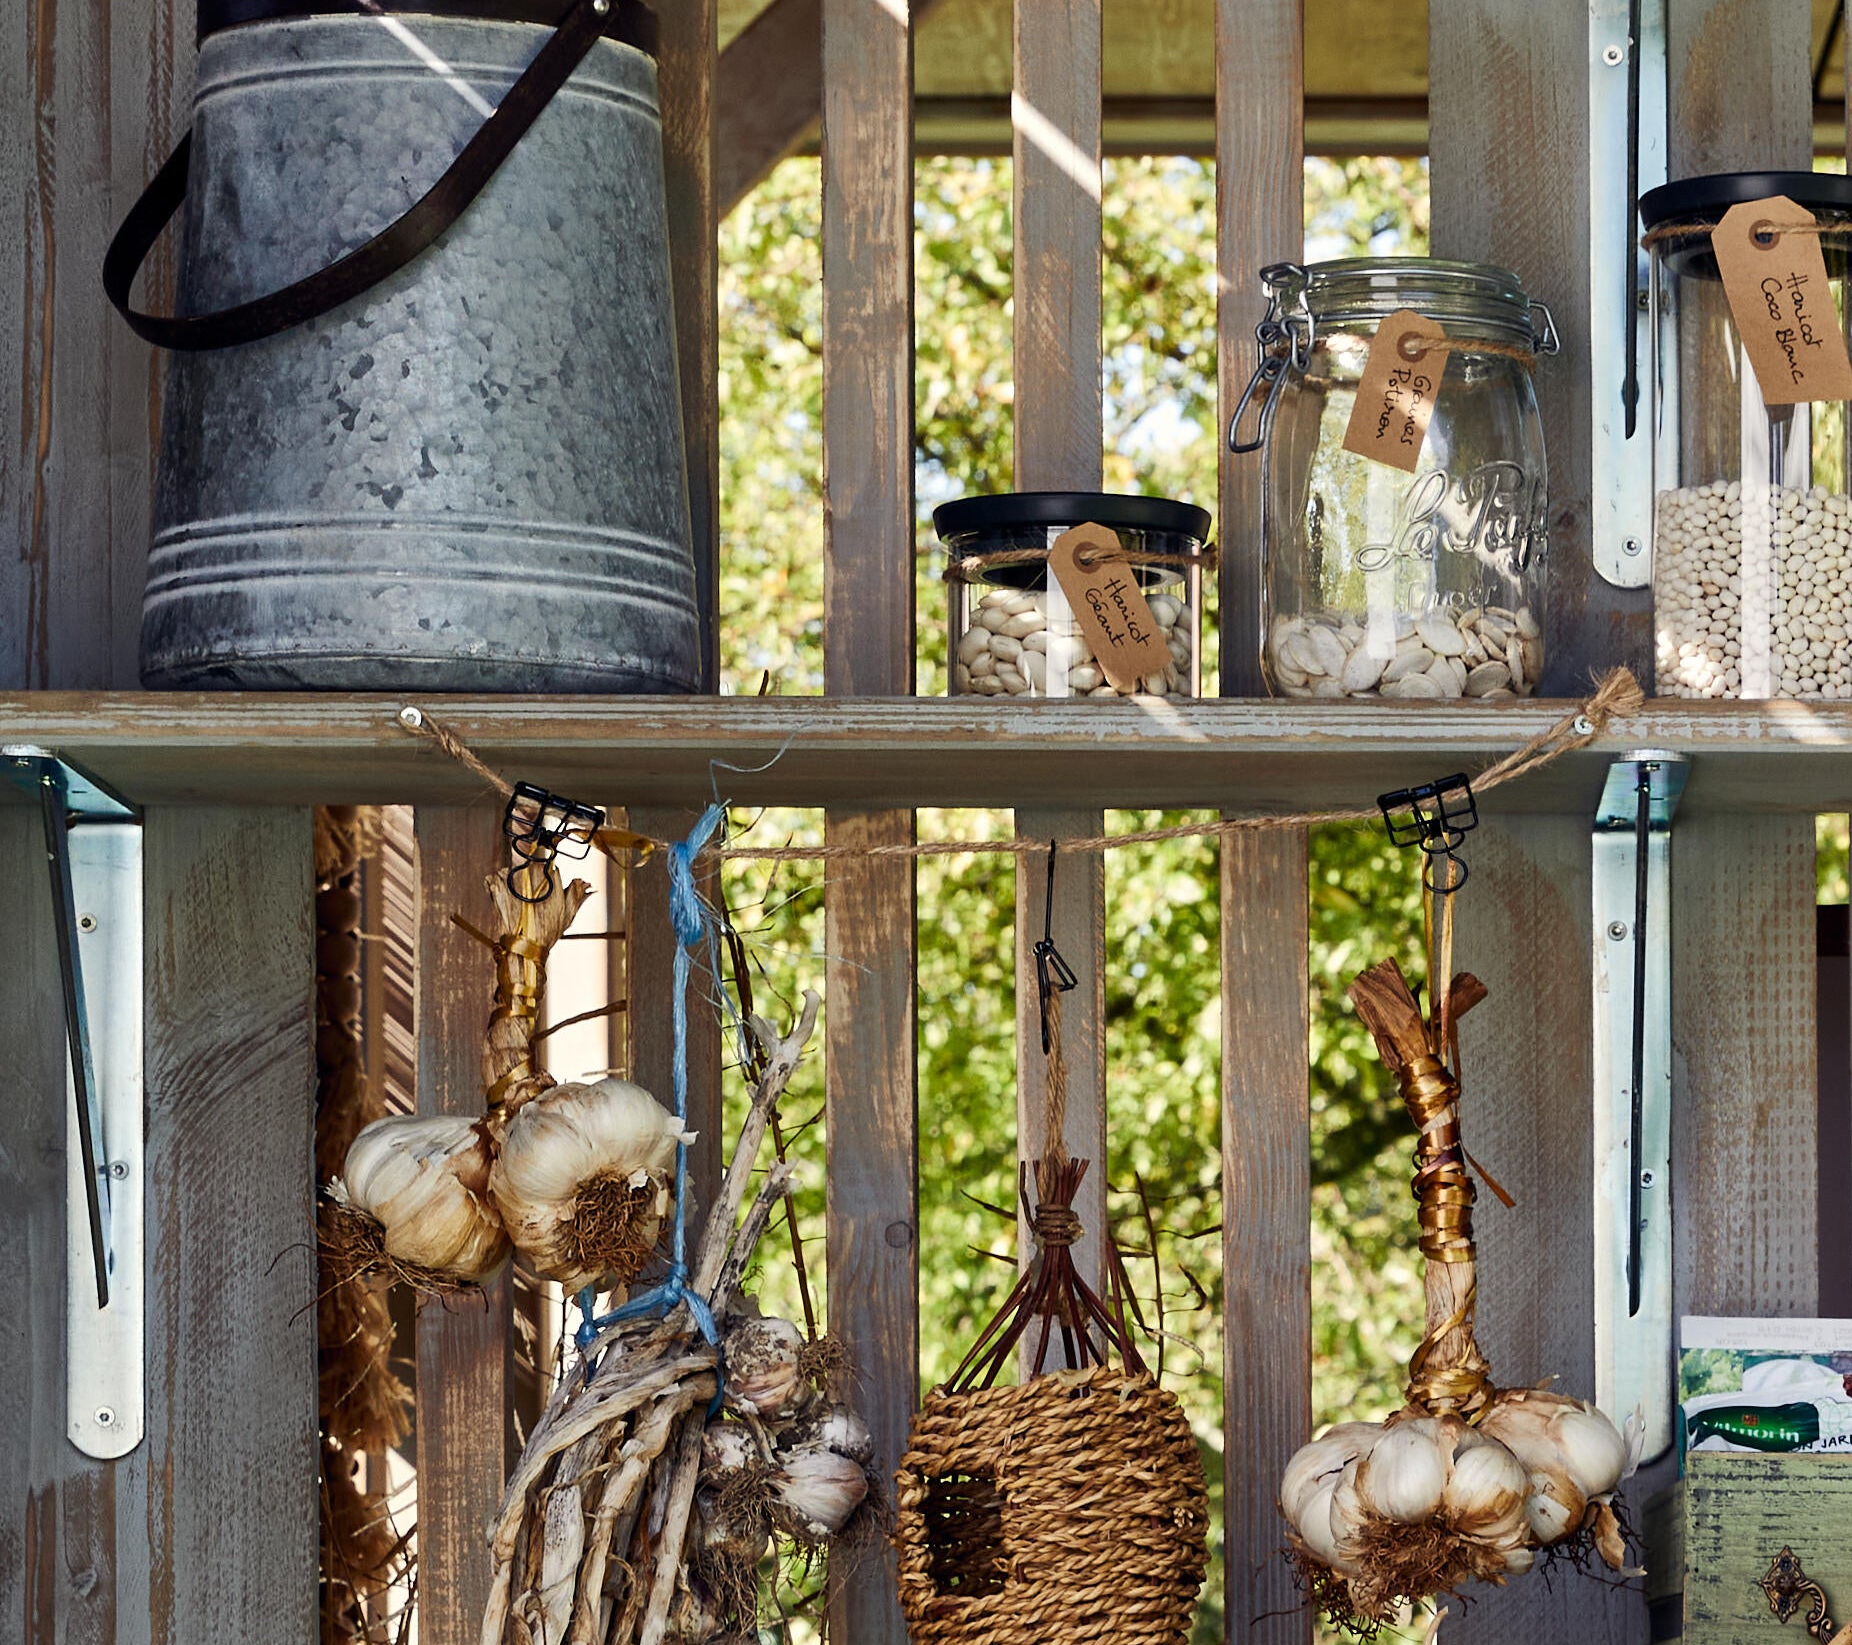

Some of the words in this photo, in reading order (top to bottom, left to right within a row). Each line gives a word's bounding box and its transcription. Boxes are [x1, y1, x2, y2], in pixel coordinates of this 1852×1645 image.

[1761, 277, 1783, 321] Coco
[1775, 328, 1804, 385] Blanc
[1786, 272, 1823, 349] Haricot
[1085, 588, 1125, 648] Géant
[1104, 578, 1150, 647] Haricot
